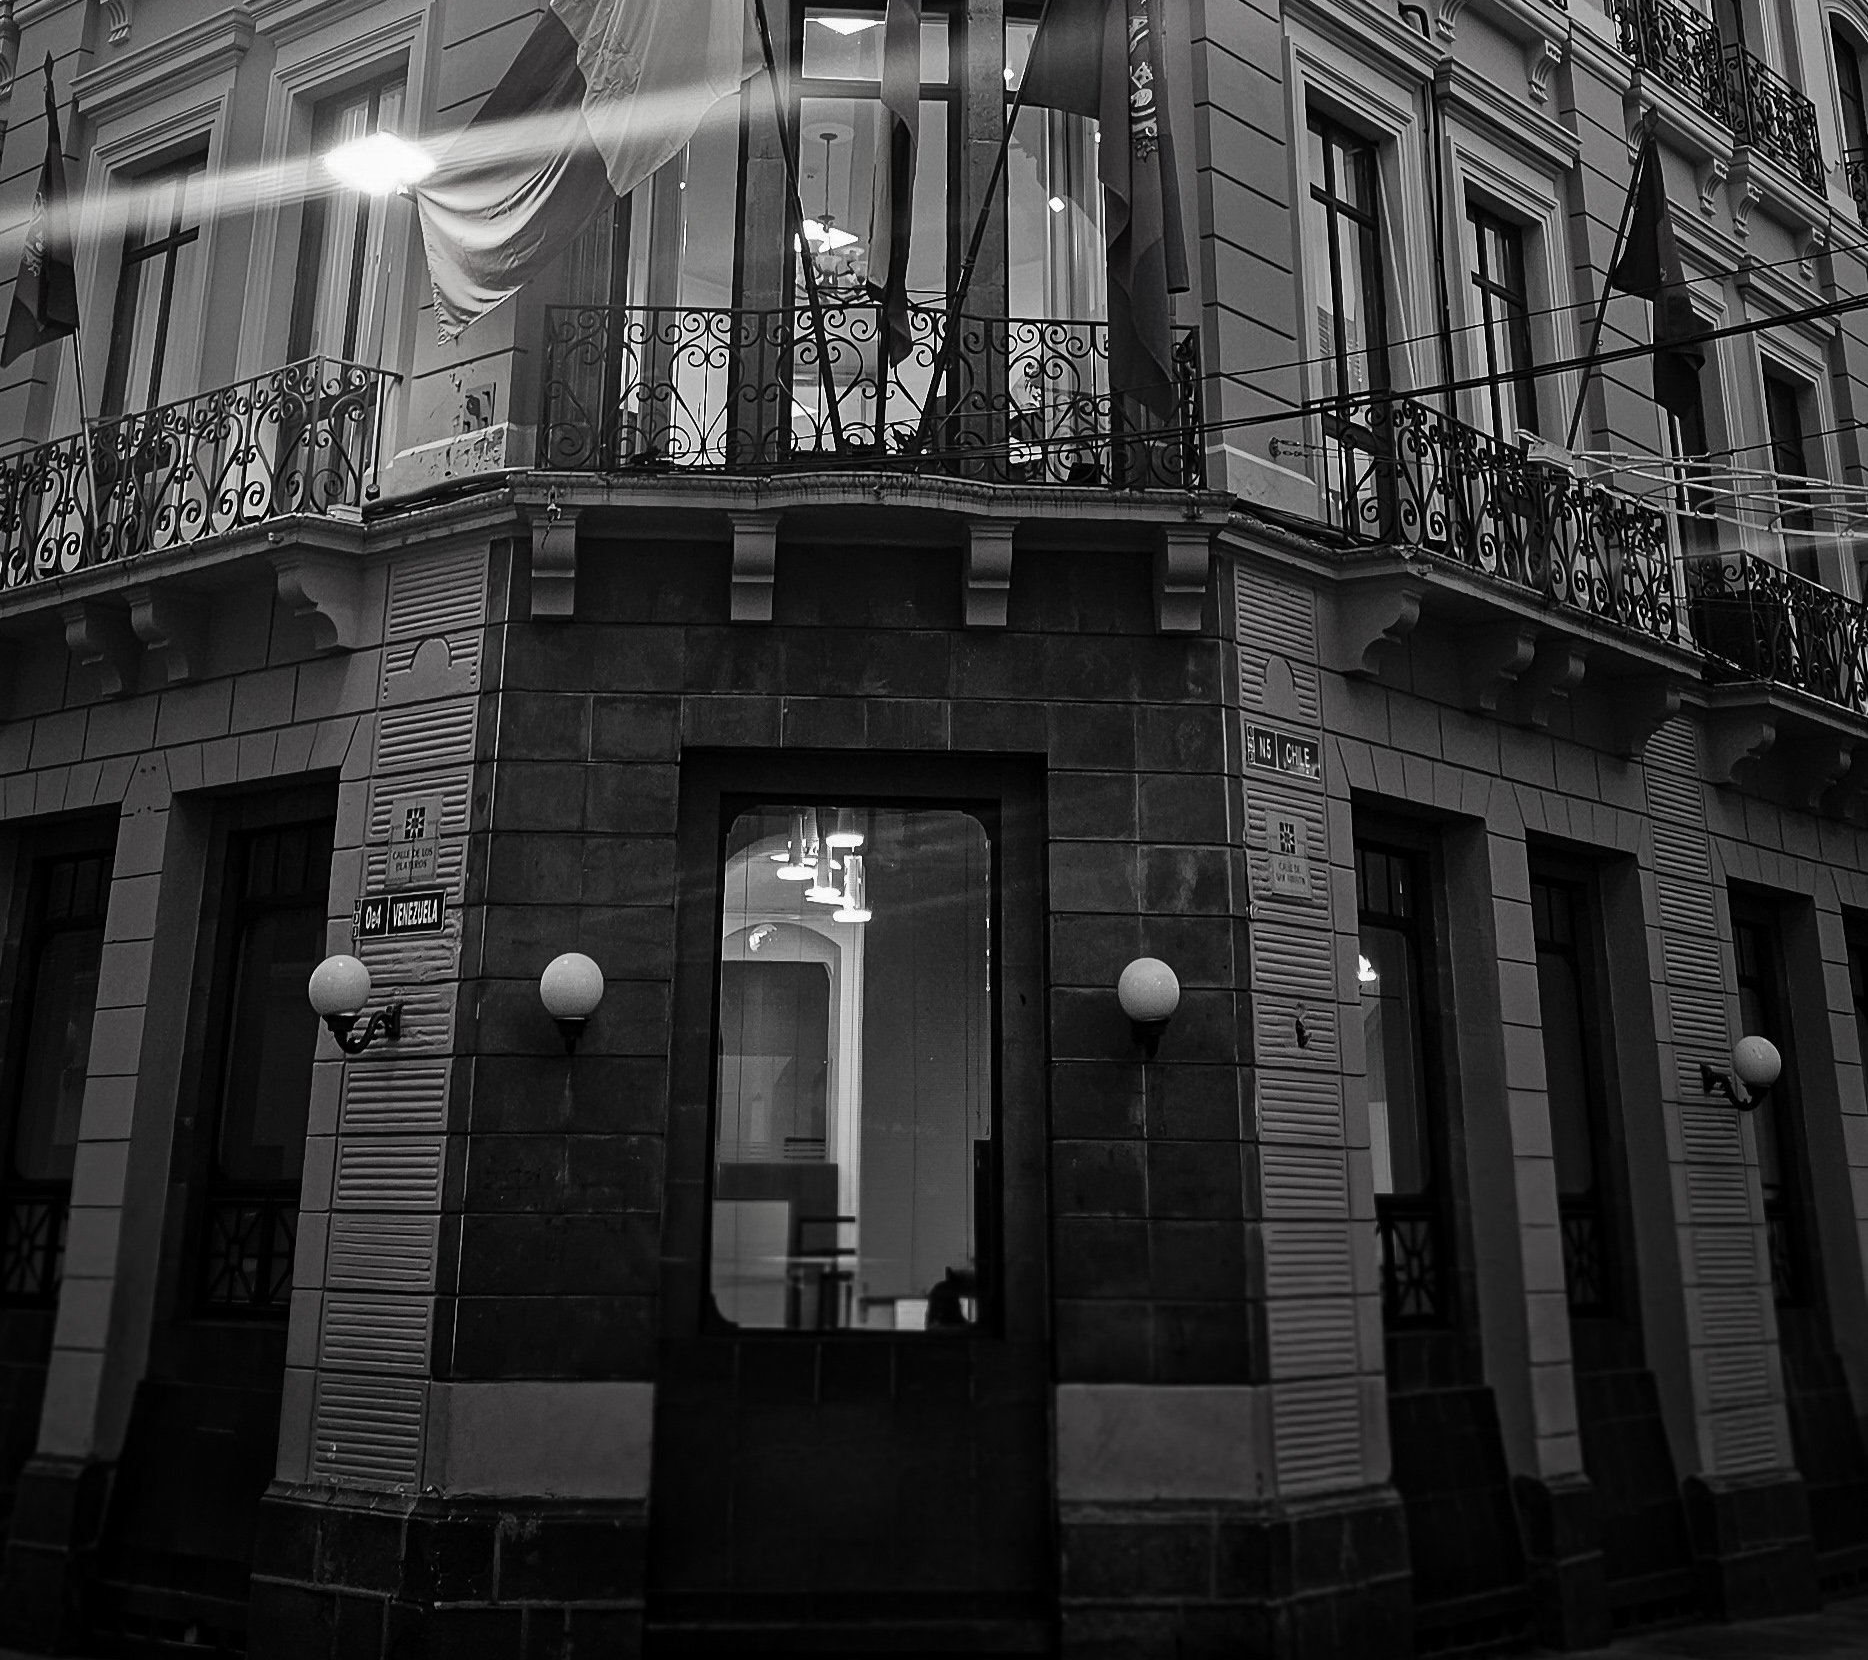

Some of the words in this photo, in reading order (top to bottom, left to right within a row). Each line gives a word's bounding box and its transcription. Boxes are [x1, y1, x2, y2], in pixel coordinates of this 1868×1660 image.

[1259, 736, 1271, 760] N5
[1286, 743, 1310, 768] CHILE
[392, 849, 410, 860] CALLE
[422, 847, 433, 857] LOS
[395, 860, 428, 872] PLATROS
[393, 899, 438, 927] VENEZUELA
